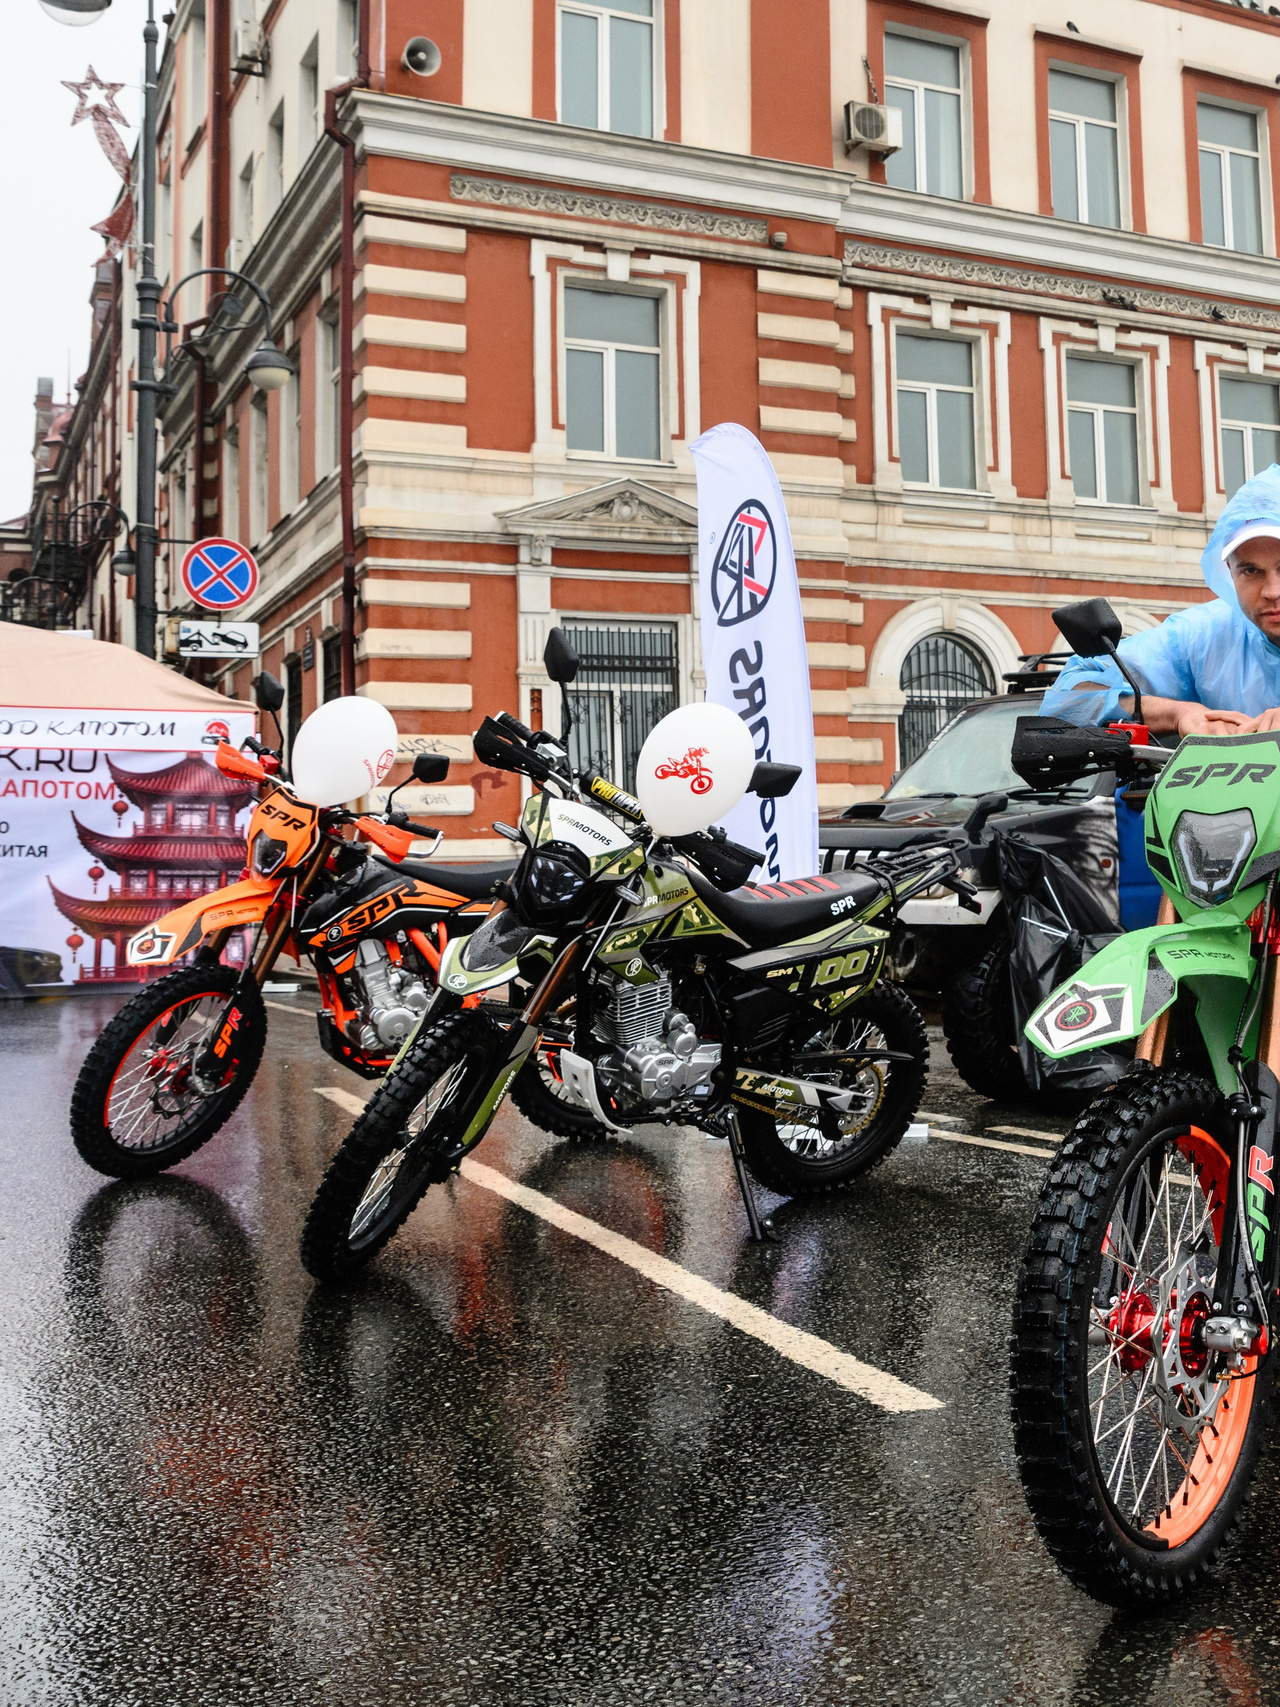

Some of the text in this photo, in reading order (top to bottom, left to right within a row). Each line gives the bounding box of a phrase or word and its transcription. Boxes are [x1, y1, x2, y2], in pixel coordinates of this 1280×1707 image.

[46, 720, 176, 737] КАПОТОМ
[1166, 762, 1277, 789] SPR
[0, 779, 115, 800] АПОТОМ
[593, 780, 641, 816] PROTAPER
[260, 804, 307, 832] SPR
[557, 813, 613, 846] SPRMOTORS
[0, 845, 47, 857] ИТАЯ
[347, 880, 428, 932] SPR
[830, 895, 857, 916] SPR
[1167, 949, 1205, 960] SPR
[766, 967, 793, 978] SM
[214, 1006, 243, 1059] SPR
